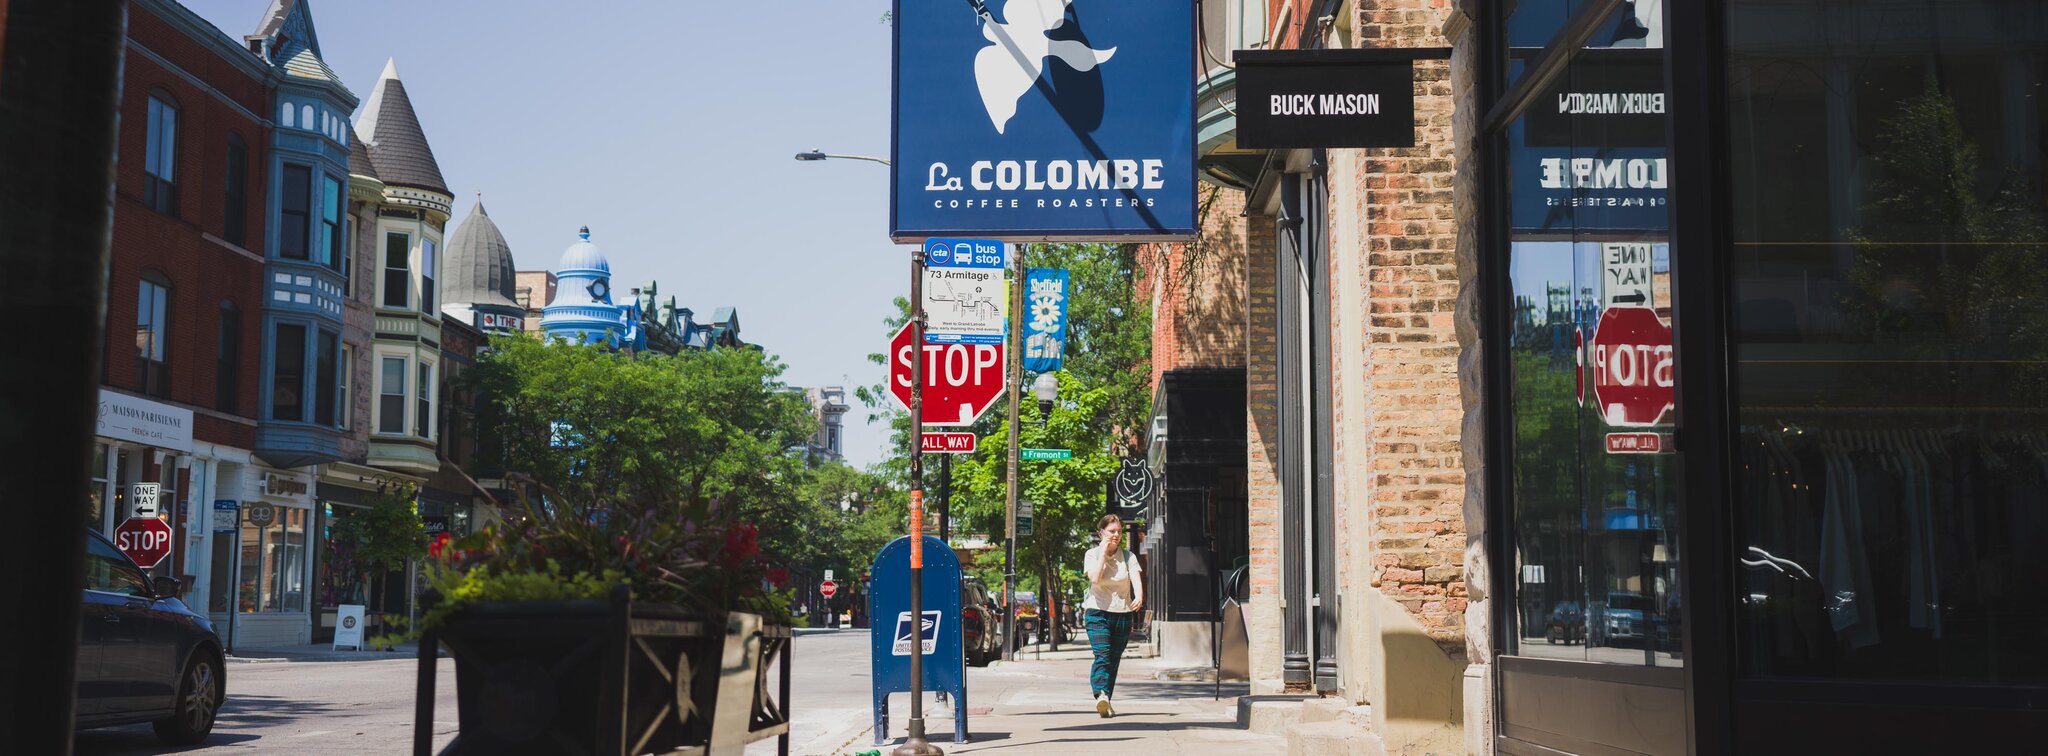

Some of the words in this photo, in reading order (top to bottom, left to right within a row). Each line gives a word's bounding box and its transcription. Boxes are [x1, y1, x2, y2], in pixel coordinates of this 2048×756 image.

[1270, 95, 1315, 115] BUCK
[1320, 94, 1379, 114] MASON
[925, 162, 964, 191] La
[971, 159, 1165, 190] COLOMBE
[934, 199, 1018, 208] COFFEE
[1037, 198, 1154, 207] ROASTERS
[932, 249, 948, 257] cta
[975, 243, 997, 254] bus
[975, 254, 1001, 266] stop
[930, 270, 942, 279] 73
[944, 270, 989, 282] Armitage
[1030, 278, 1063, 293] Sheffield
[499, 316, 516, 328] THE
[897, 344, 998, 388] STOP
[112, 404, 140, 419] MAISON
[141, 410, 182, 428] PARISIENNE
[921, 436, 943, 448] ALL
[947, 436, 970, 448] WAY
[1028, 451, 1061, 459] Fremont
[134, 486, 155, 495] ONE
[133, 496, 155, 505] WAY
[119, 530, 168, 551] STOP
